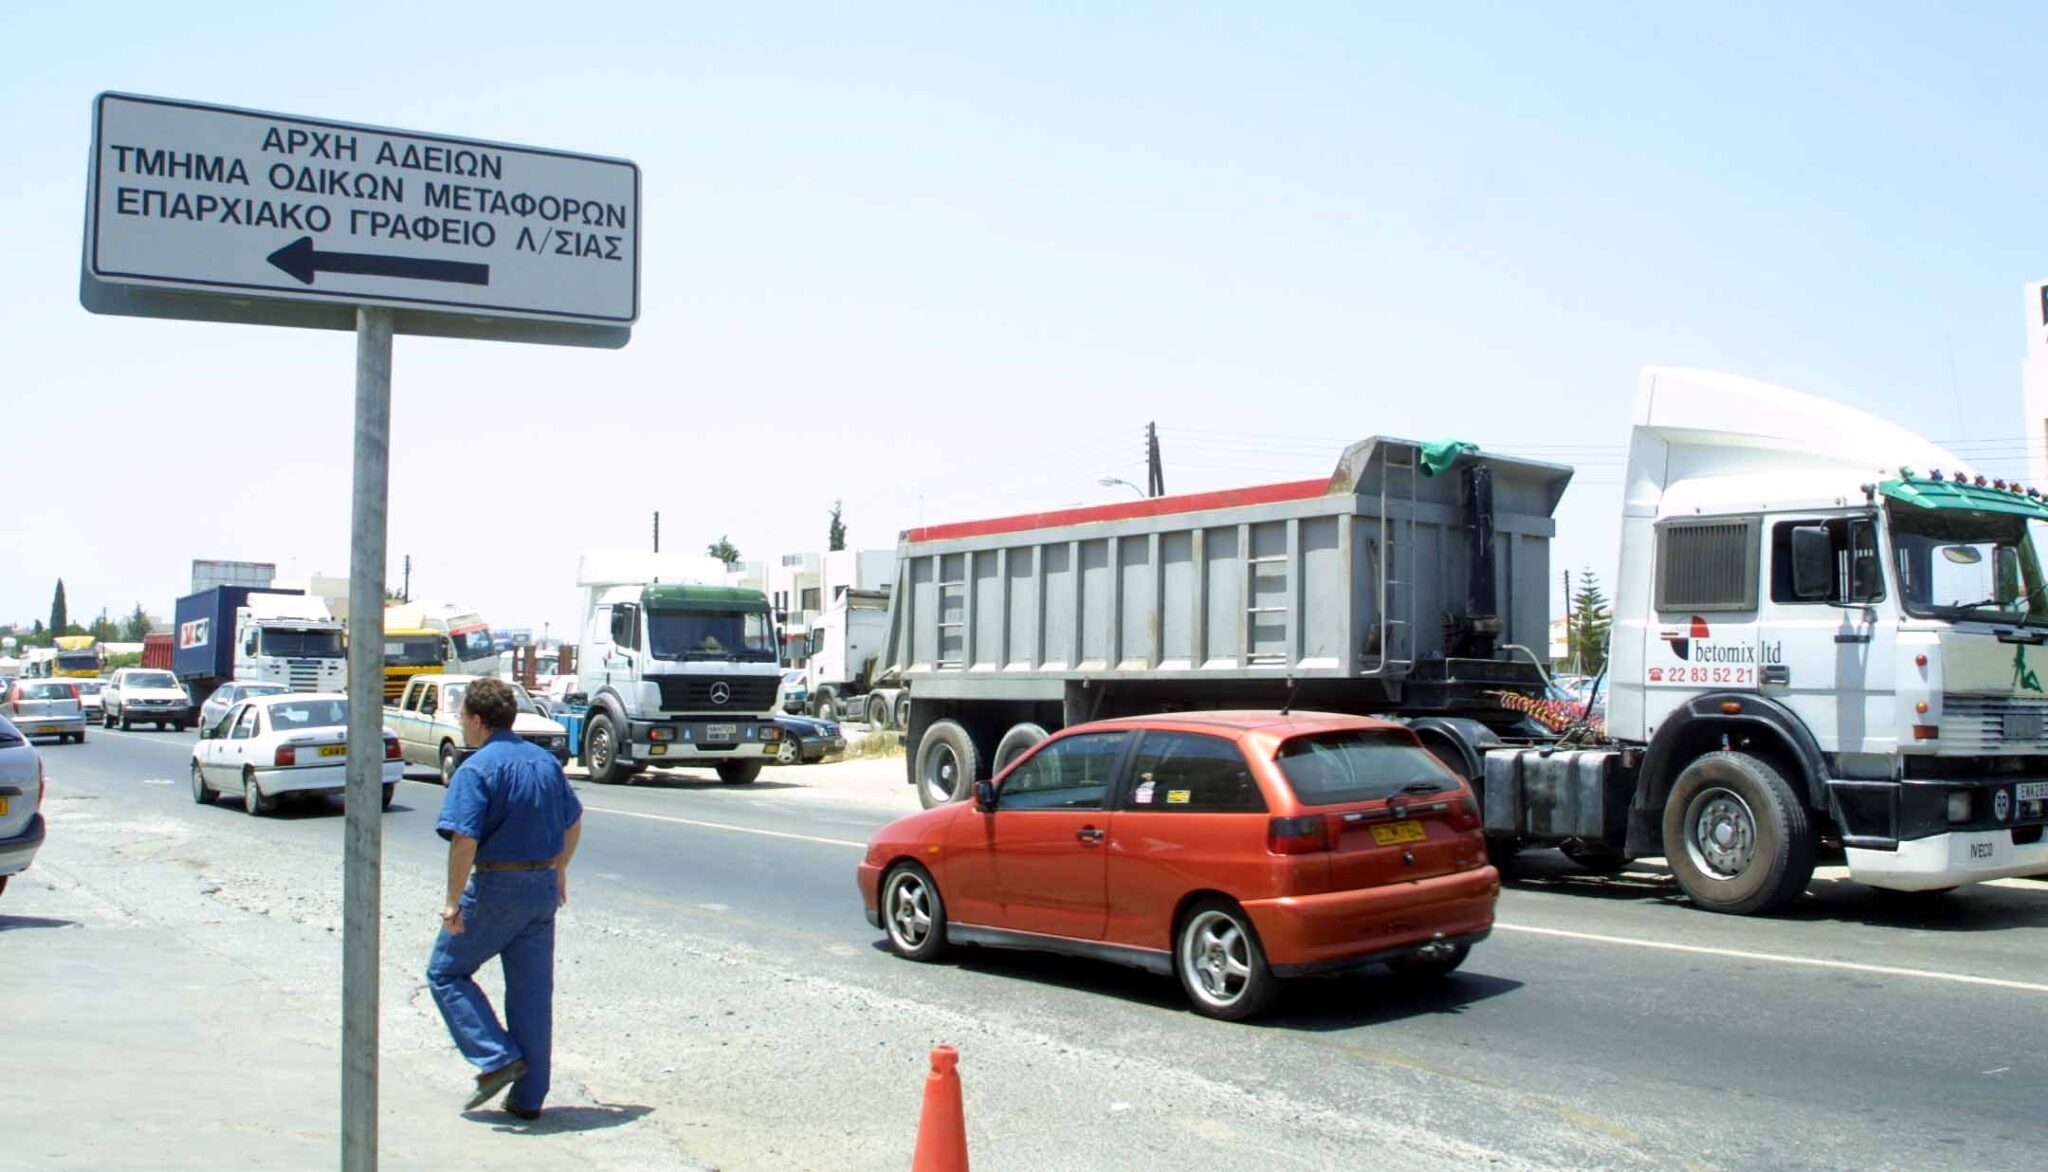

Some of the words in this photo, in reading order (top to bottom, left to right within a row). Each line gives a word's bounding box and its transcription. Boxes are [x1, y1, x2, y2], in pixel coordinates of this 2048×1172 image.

[262, 127, 357, 162] ΑΡΧΗ
[375, 141, 502, 180] ΑΔΕΙΩΝ
[110, 145, 250, 185] ΤΜΗΜΑ
[269, 163, 403, 203] ΟΔΙΚΩΝ
[425, 182, 626, 229] ΜΕΤΑΦΟΡΩΝ
[117, 187, 331, 232] ΕΠΑΡΧΙΑΚΟ
[351, 209, 496, 248] ΓΡΑΦΕΙΟ
[516, 227, 623, 261] Λ/ΣΙΑΣ
[1695, 640, 1755, 662] betomix
[1761, 641, 1781, 663] ltd
[1669, 667, 1685, 682] 22
[1691, 667, 1708, 682] 83
[1713, 667, 1730, 682] 52
[1736, 668, 1753, 683] 21
[1970, 843, 1993, 858] IVECO
